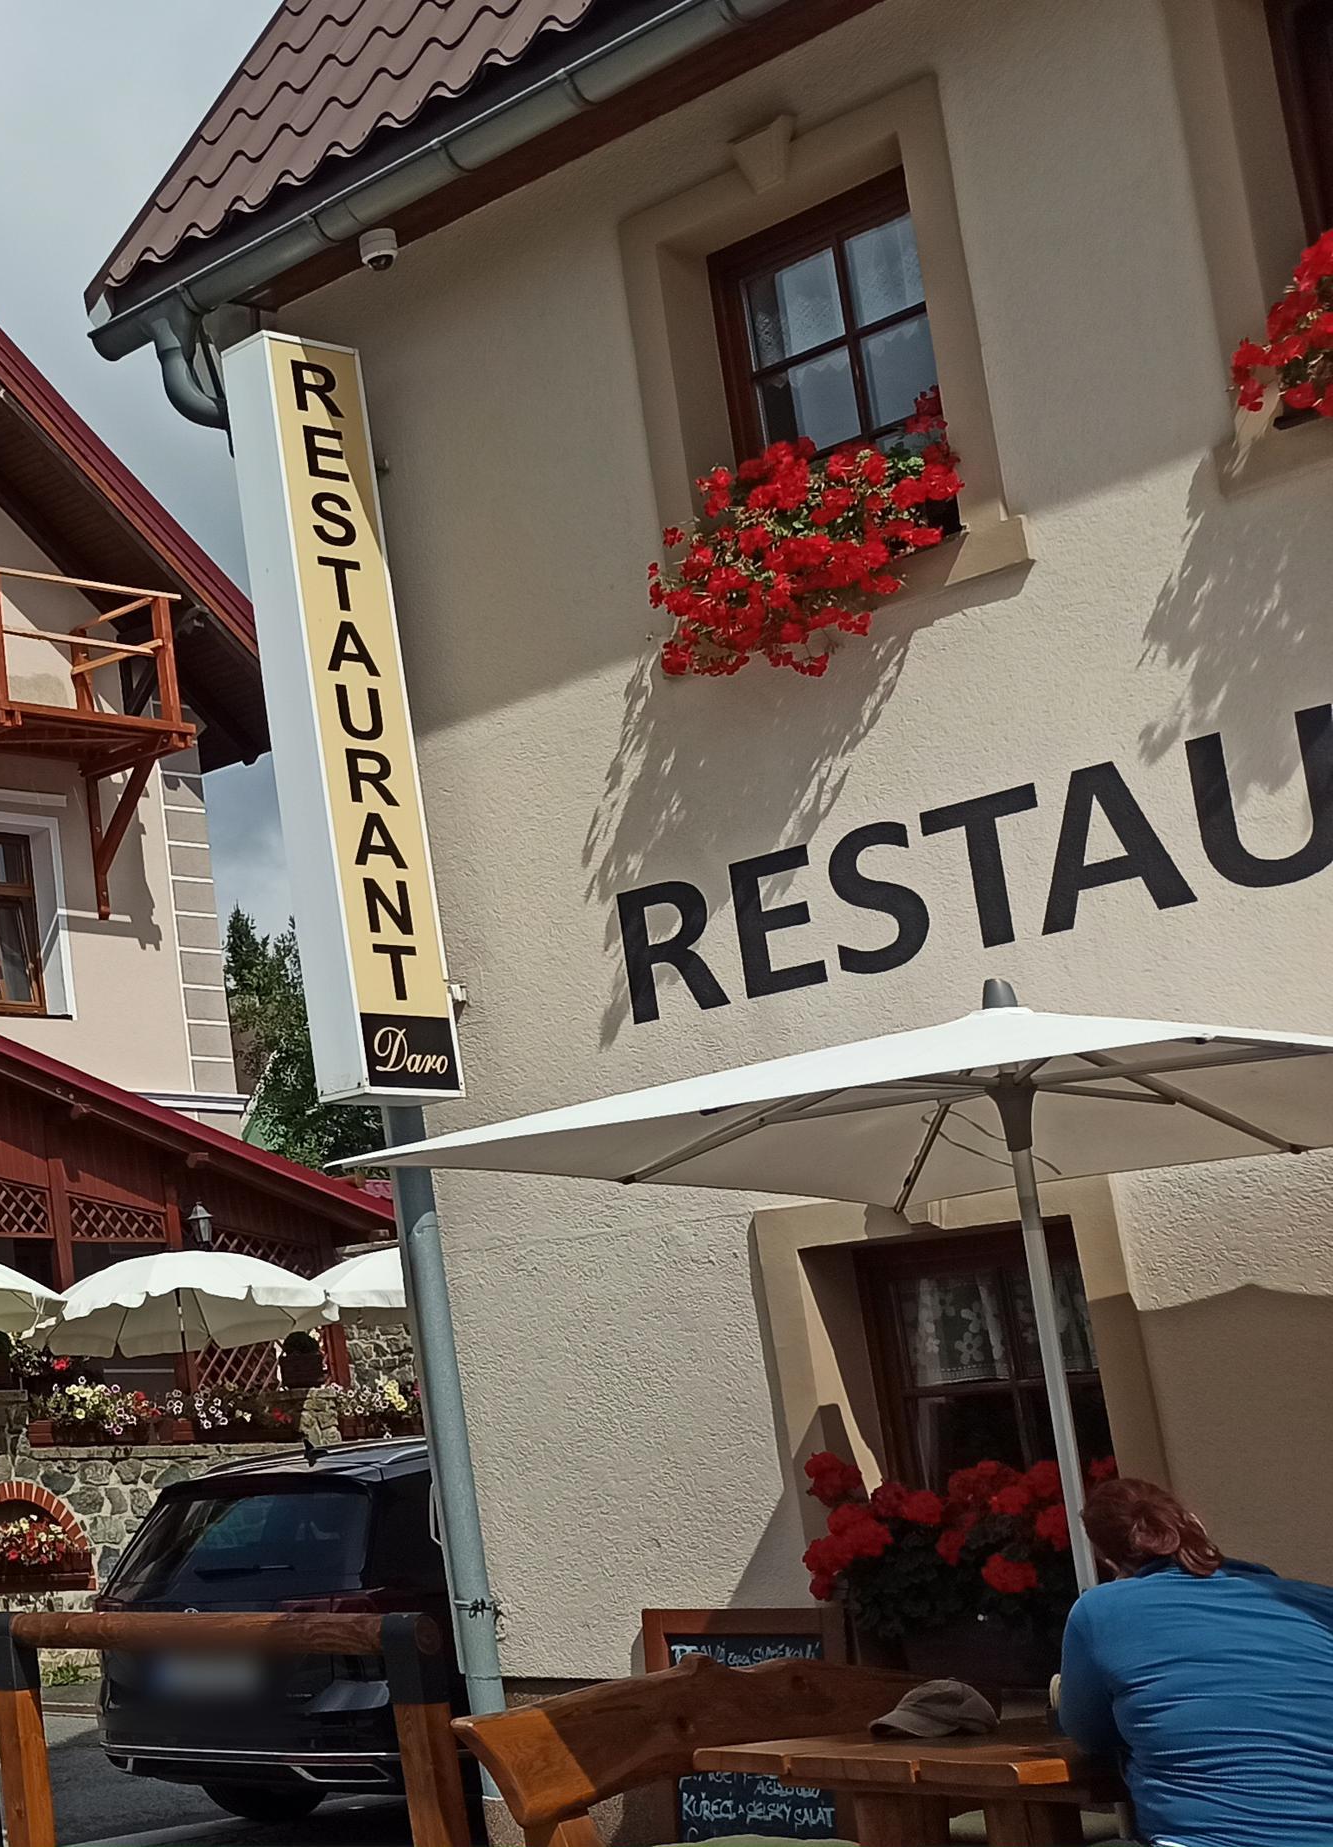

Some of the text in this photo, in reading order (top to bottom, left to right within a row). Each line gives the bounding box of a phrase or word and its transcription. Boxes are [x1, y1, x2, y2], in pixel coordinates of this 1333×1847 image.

[290, 359, 416, 1003] RESTAURANT
[616, 703, 1333, 1026] RESTAU
[374, 1026, 449, 1075] Daro
